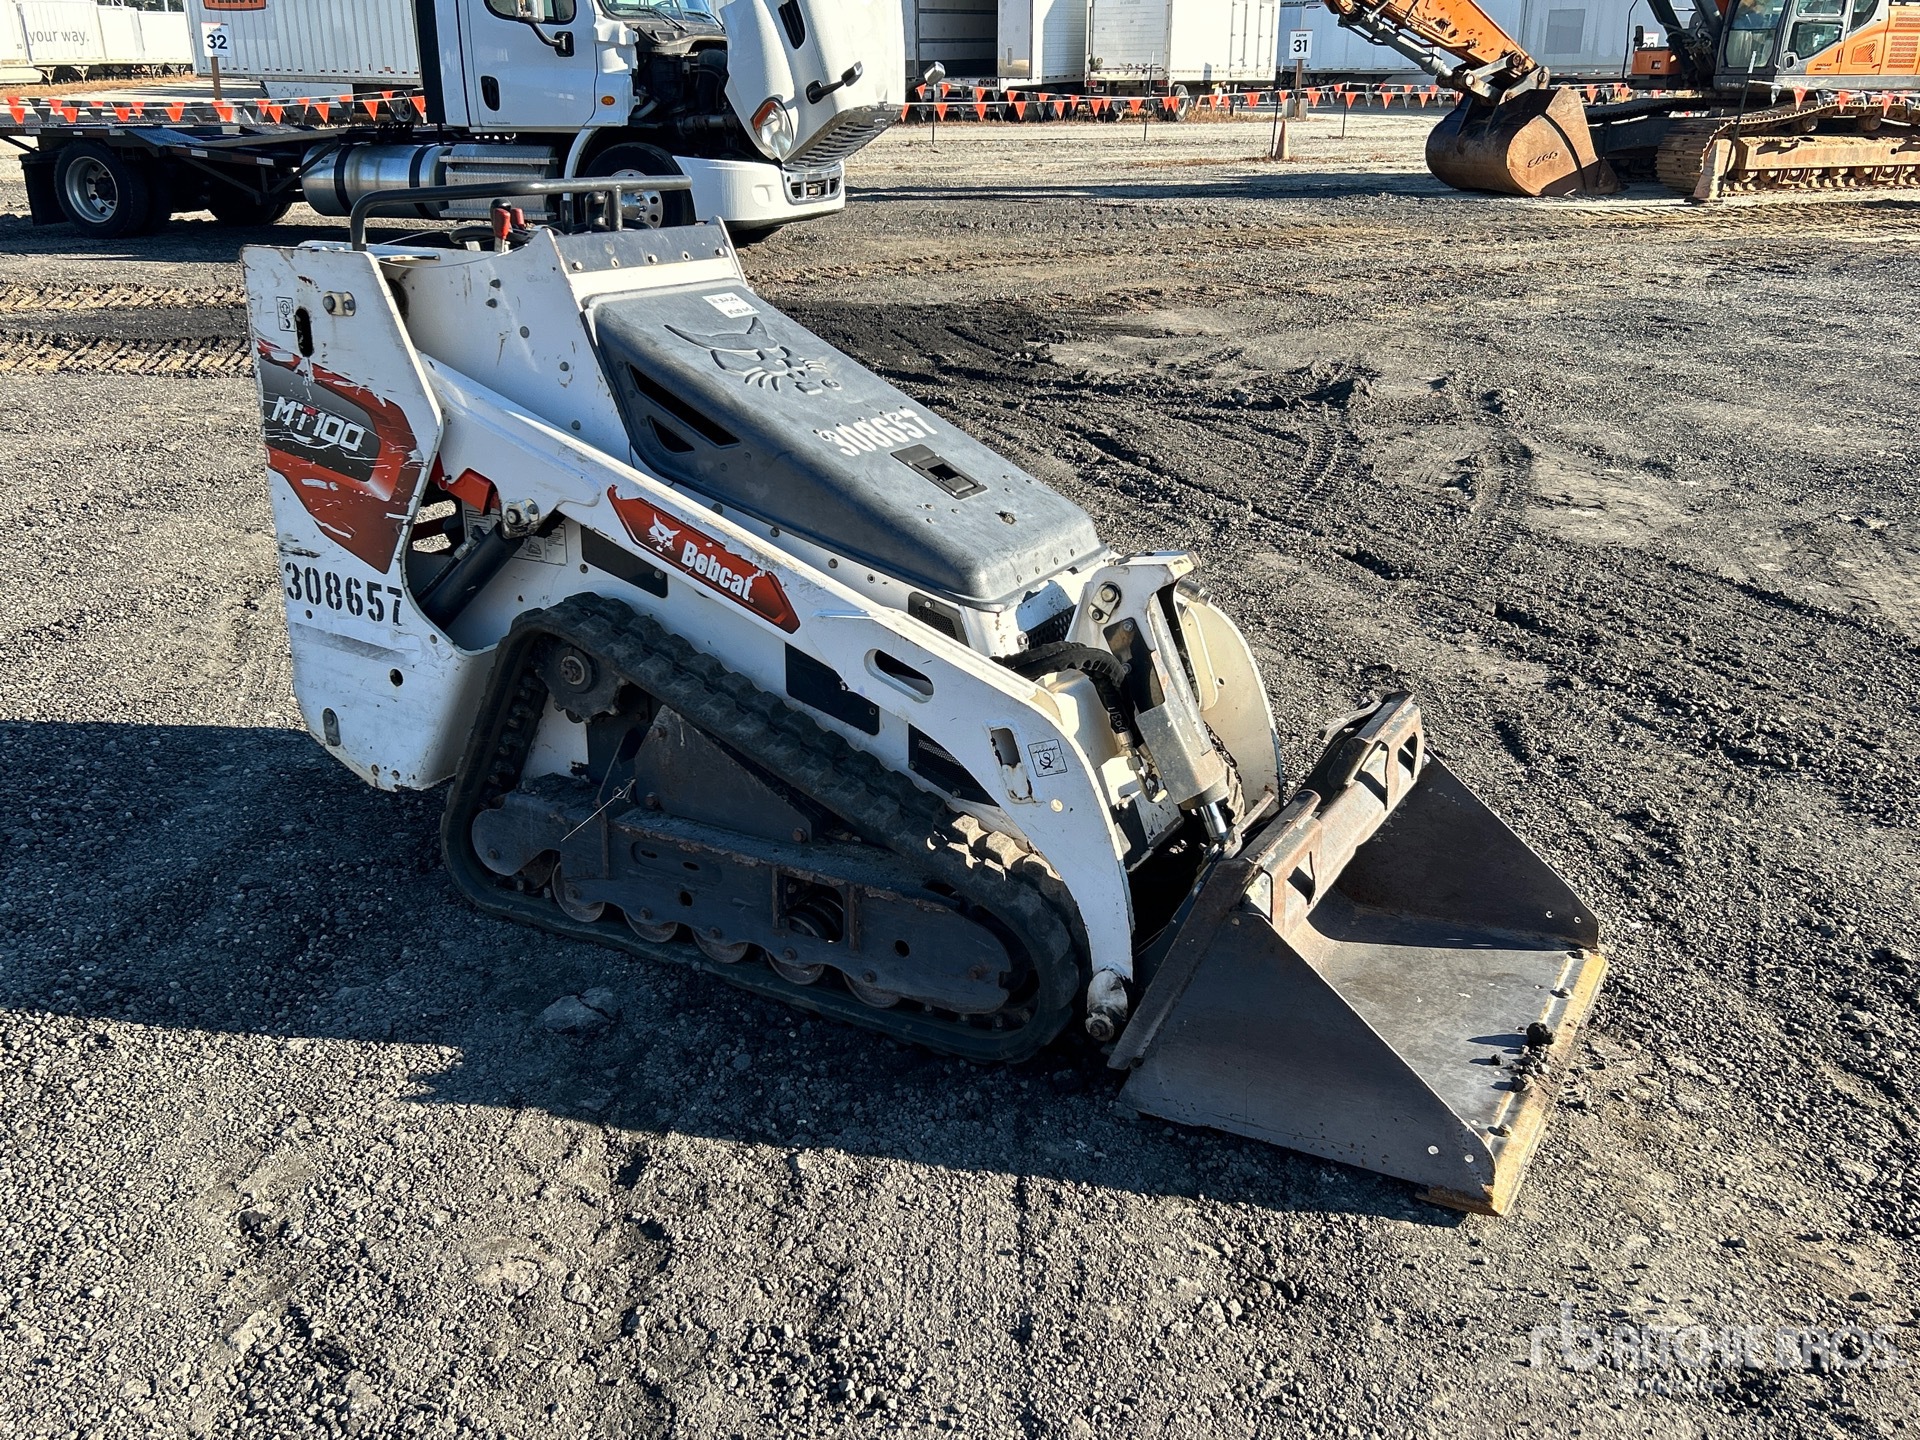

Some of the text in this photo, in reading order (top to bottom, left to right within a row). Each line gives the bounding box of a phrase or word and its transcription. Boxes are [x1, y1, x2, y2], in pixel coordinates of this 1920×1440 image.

[28, 31, 90, 46] your way.
[206, 34, 228, 50] 32
[1293, 39, 1308, 53] 31
[271, 396, 366, 452] MT100
[818, 407, 938, 457] 308657
[285, 562, 403, 626] 308657
[680, 540, 753, 601] Bobcat
